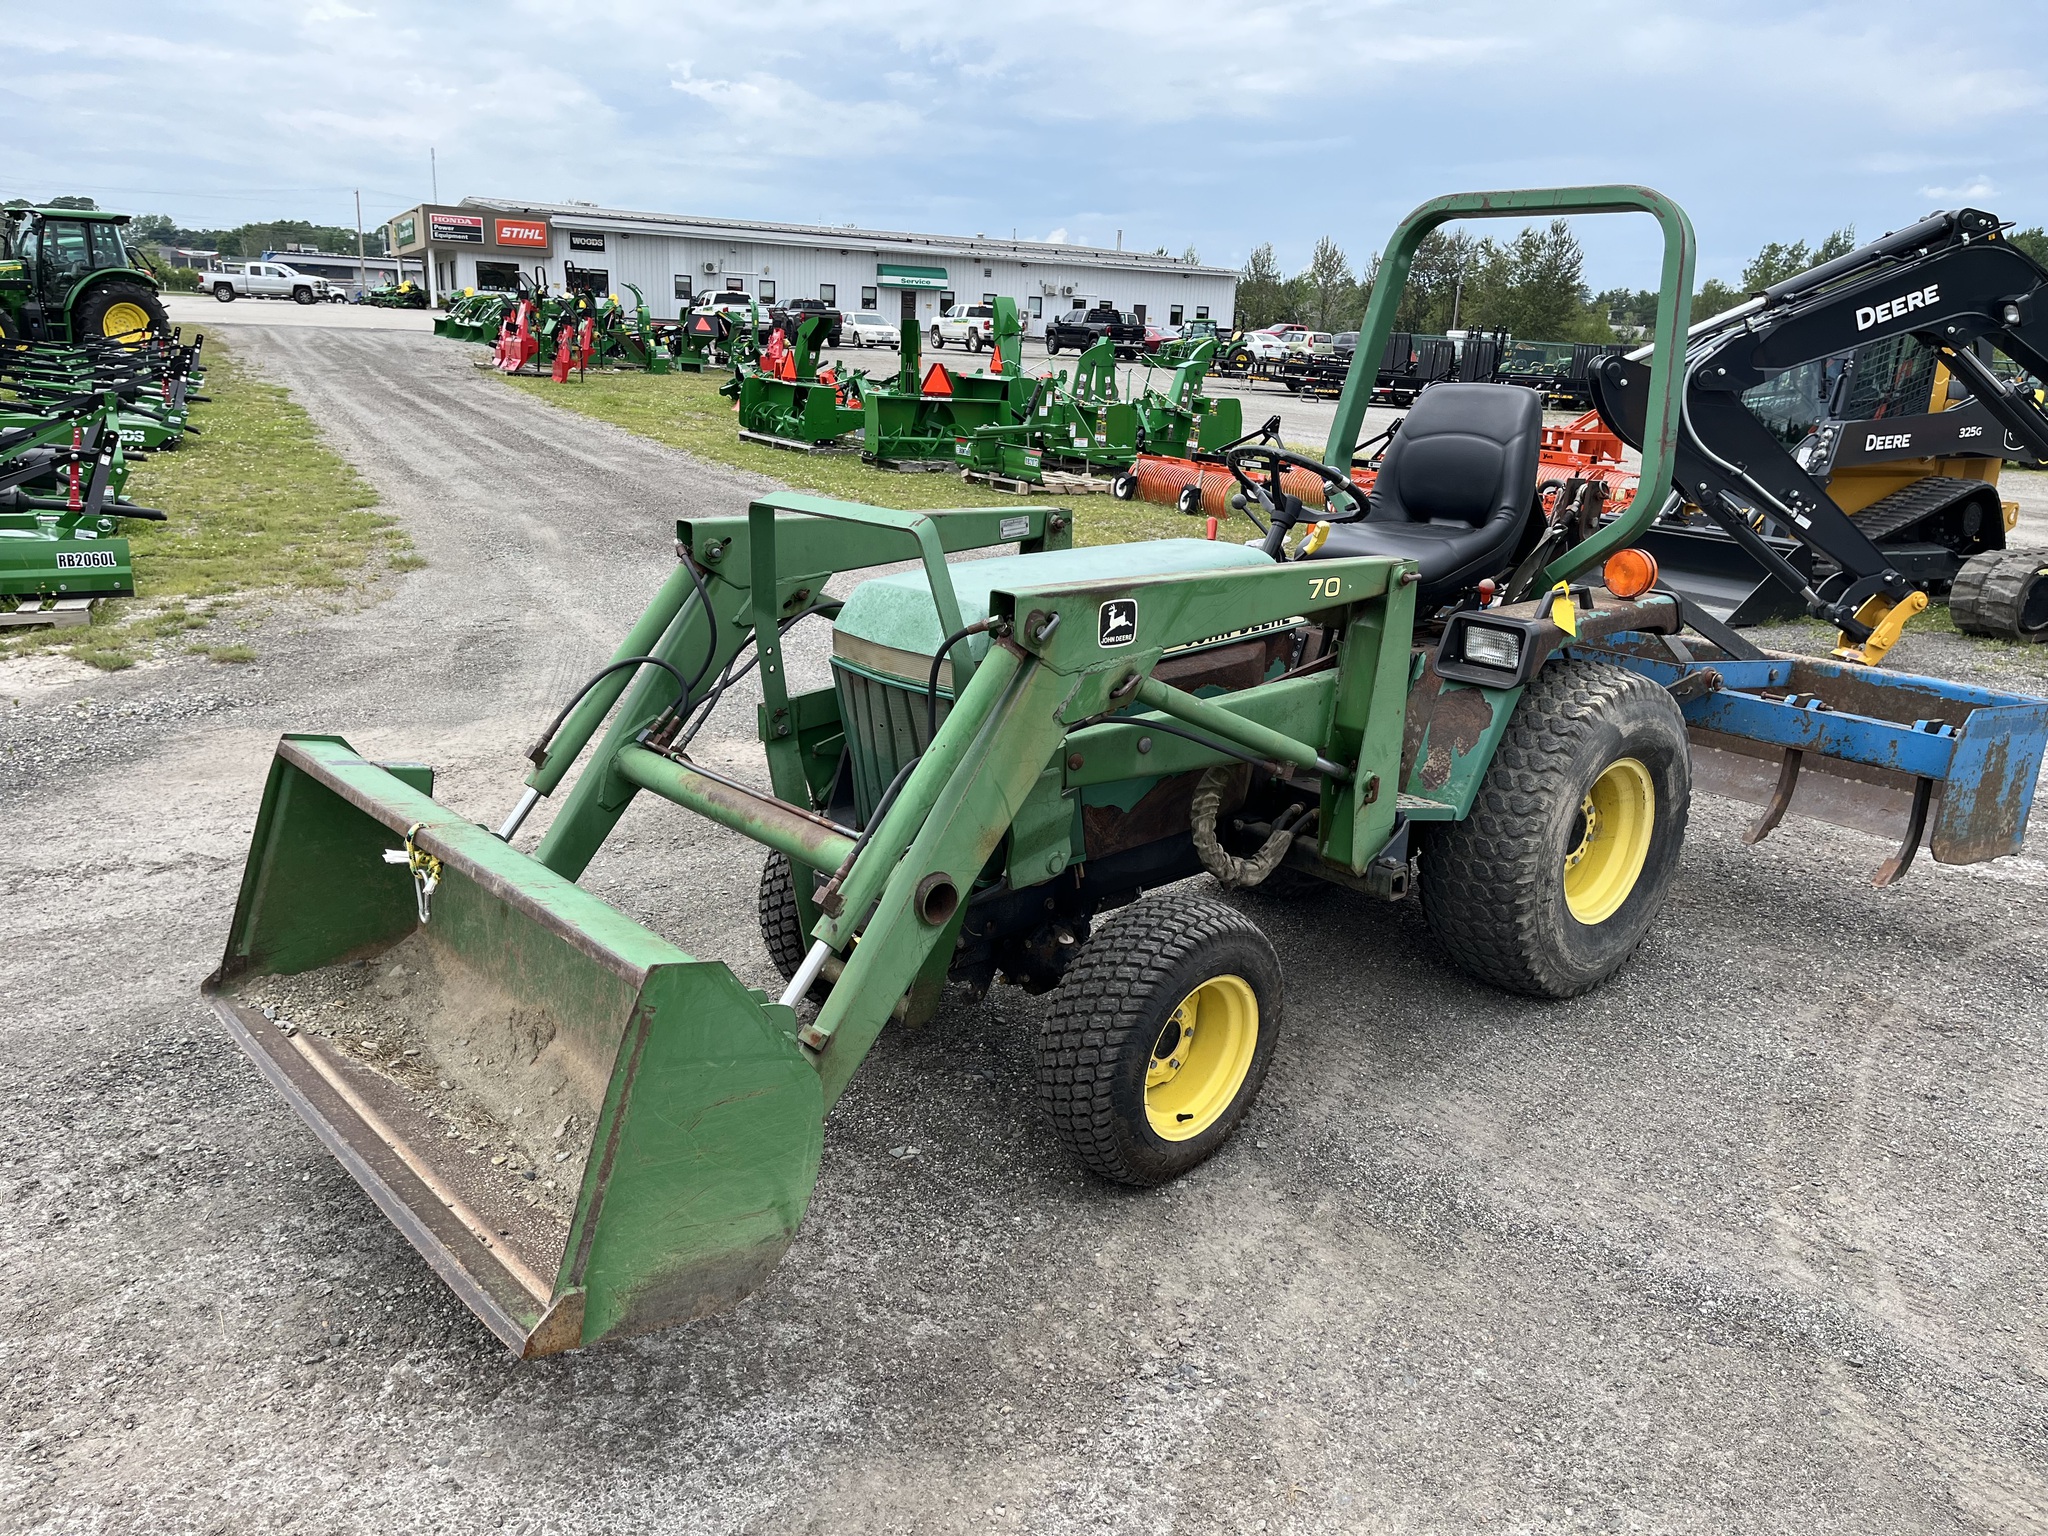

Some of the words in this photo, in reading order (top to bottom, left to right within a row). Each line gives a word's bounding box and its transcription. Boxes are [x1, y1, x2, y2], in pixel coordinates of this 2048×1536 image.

[433, 216, 472, 225] HONDA
[434, 232, 469, 240] Equipment
[501, 227, 544, 240] STIHL
[571, 237, 604, 247] WOODS
[900, 277, 931, 285] Service
[1855, 283, 1940, 331] DEERE
[1958, 426, 1983, 438] 325G
[1865, 433, 1912, 451] DEERE
[57, 552, 116, 568] RB2060L
[1308, 576, 1342, 600] 70
[1101, 636, 1116, 645] JOHN
[1115, 633, 1133, 643] DEERE
